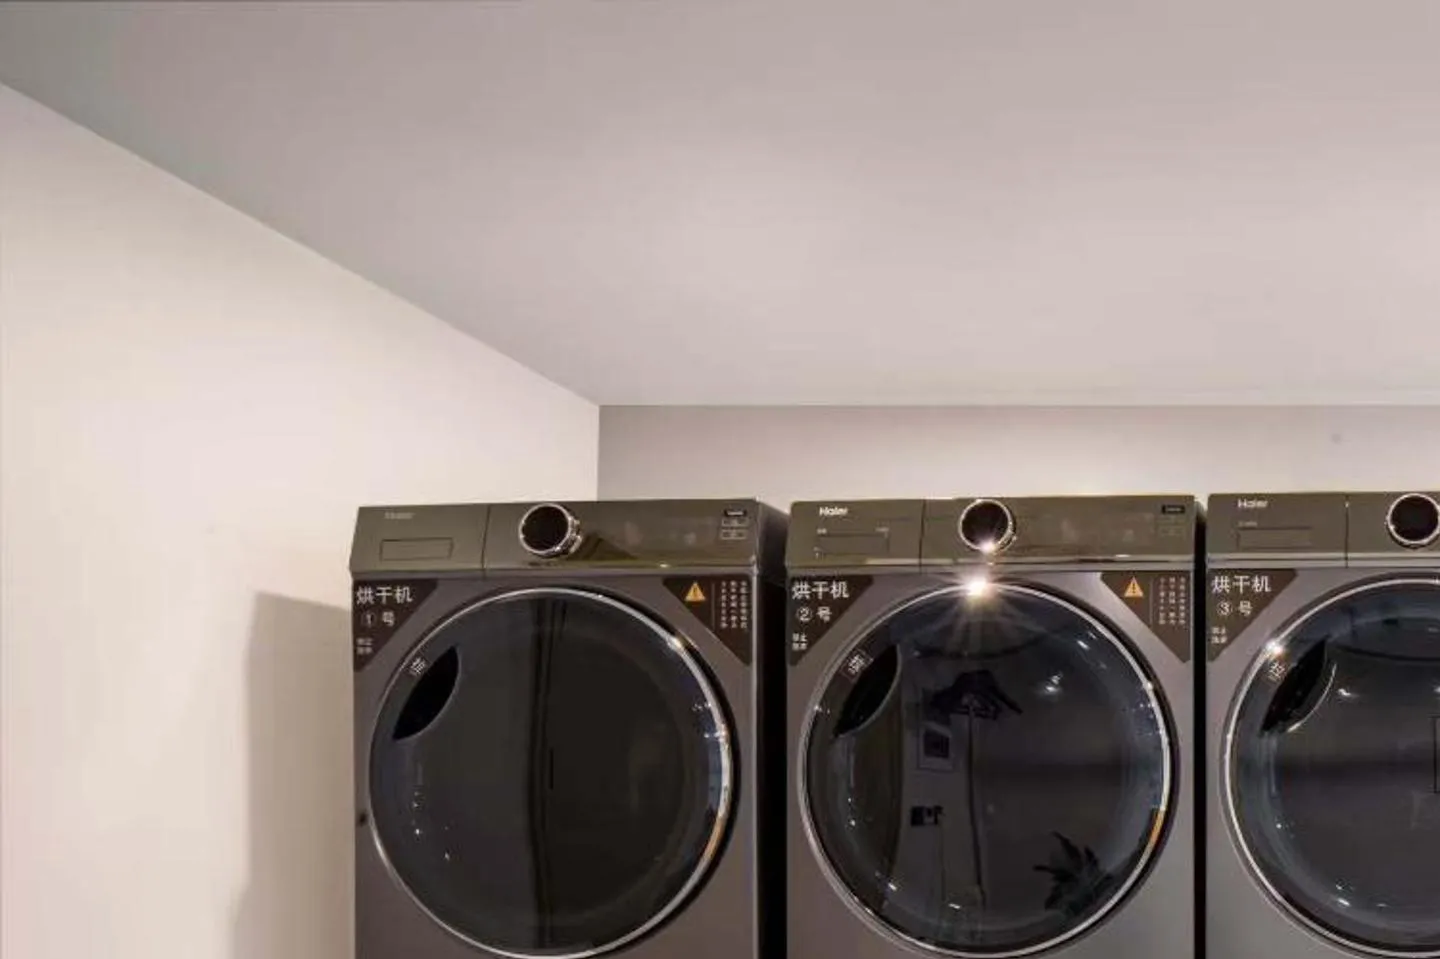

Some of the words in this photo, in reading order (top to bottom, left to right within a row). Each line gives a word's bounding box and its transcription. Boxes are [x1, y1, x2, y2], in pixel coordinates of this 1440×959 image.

[792, 581, 849, 600] 烘干机
[1211, 575, 1271, 594] 烘干机
[356, 586, 413, 605] 烘干机
